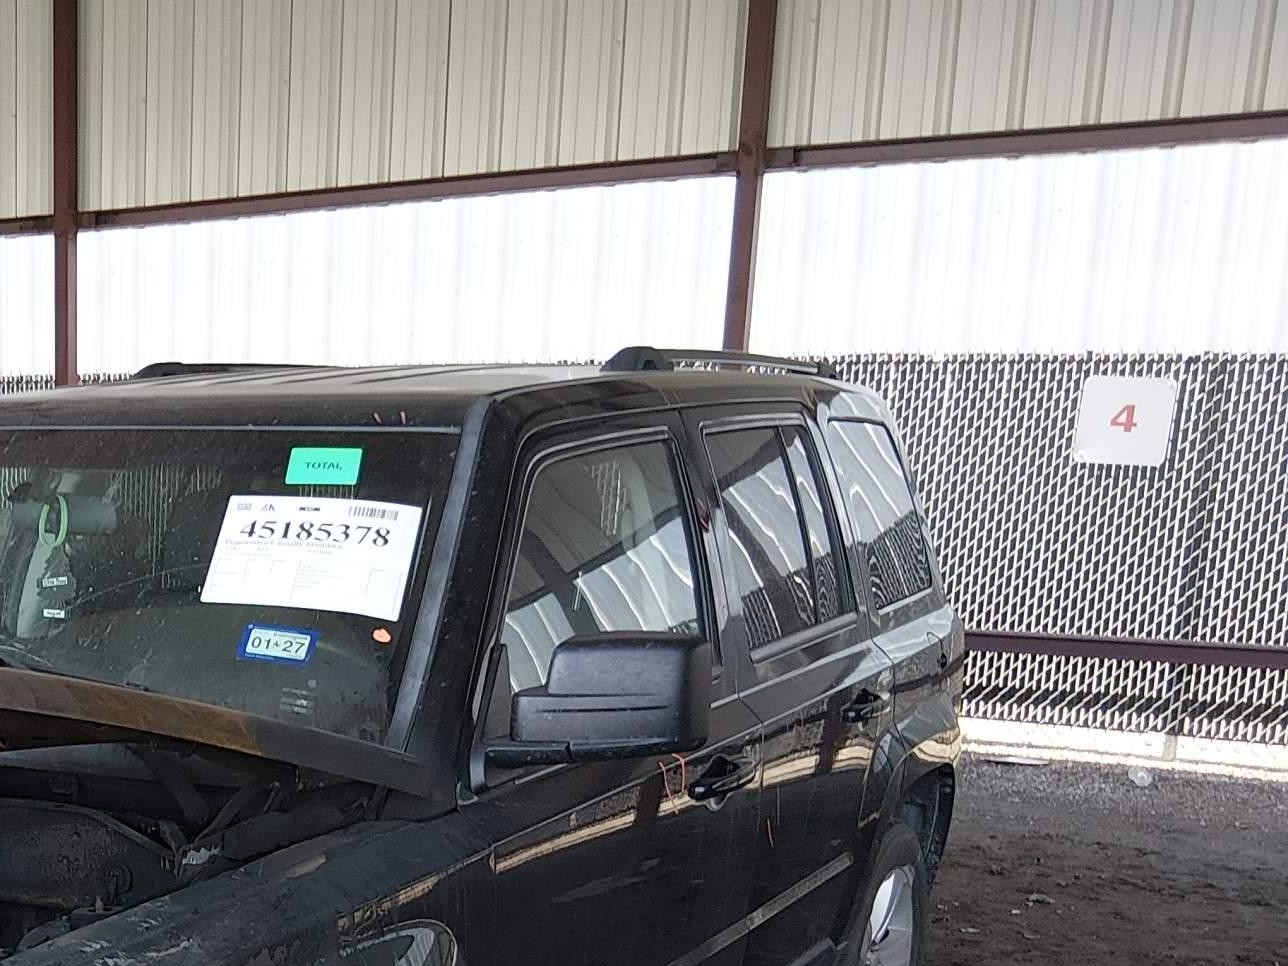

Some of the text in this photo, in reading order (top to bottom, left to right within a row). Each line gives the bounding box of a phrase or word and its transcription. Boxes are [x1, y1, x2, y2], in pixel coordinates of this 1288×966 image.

[1110, 404, 1137, 433] 4
[304, 460, 343, 471] TOTAL
[240, 520, 391, 547] 45185378
